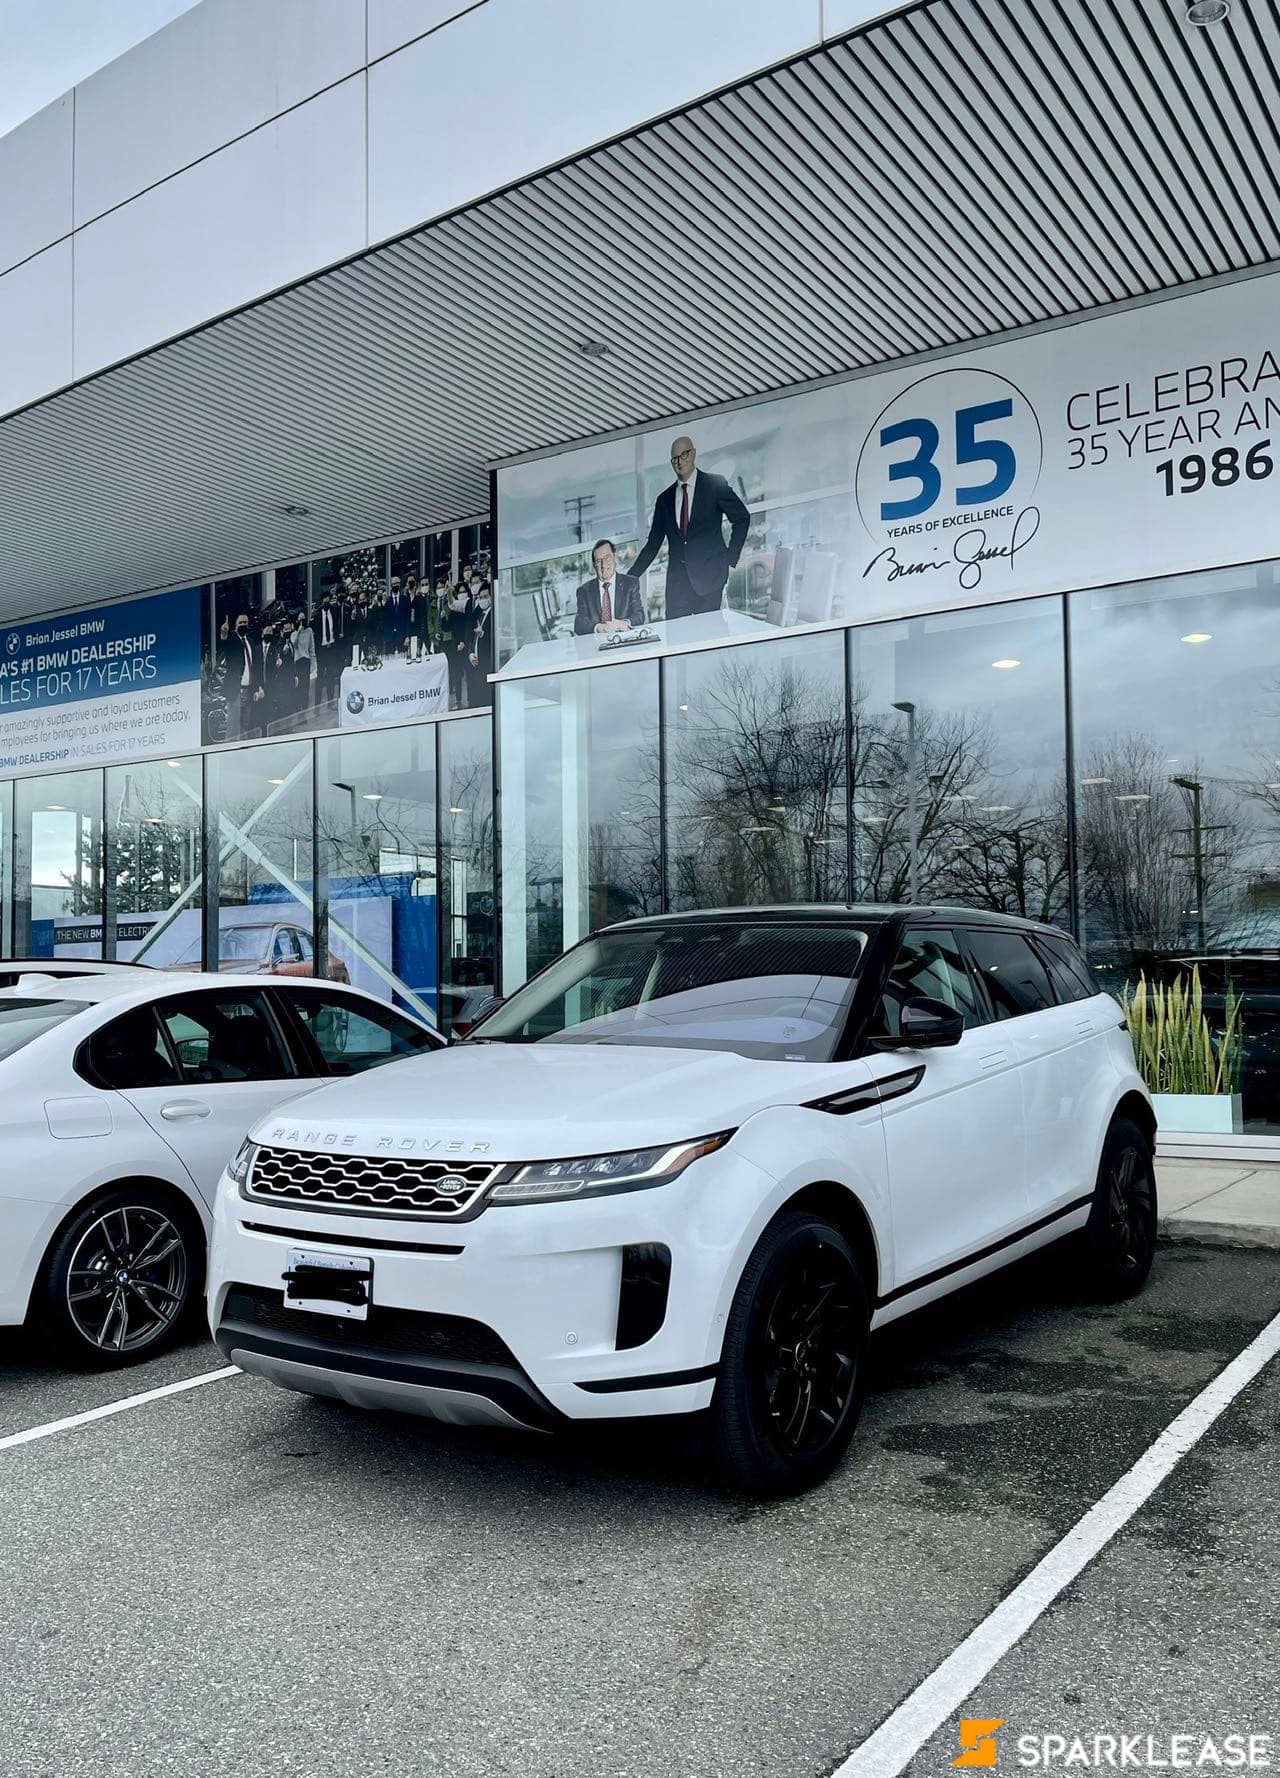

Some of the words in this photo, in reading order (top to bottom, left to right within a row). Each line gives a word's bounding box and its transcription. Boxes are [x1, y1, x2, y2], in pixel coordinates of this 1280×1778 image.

[1067, 350, 1280, 431] CELEBRA
[1068, 432, 1108, 470] 35
[1118, 408, 1222, 458] YEAR
[880, 397, 1017, 521] 35
[1156, 438, 1274, 497] 1986
[887, 522, 923, 539] YEARS
[925, 519, 941, 533] OF
[942, 505, 1014, 529] EXCELLENCE
[26, 633, 50, 647] Brian
[50, 625, 78, 643] Jessel
[80, 619, 105, 636] BMW
[0, 661, 19, 678] A'S
[21, 657, 34, 674] #1
[37, 650, 69, 671] BMW
[71, 633, 157, 665] DEALERSHIP
[0, 679, 31, 704] LES
[36, 671, 72, 699] FOR
[76, 667, 92, 691] 17
[96, 655, 157, 687] YEARS
[368, 696, 390, 707] Brian
[391, 690, 417, 703] Jessel
[419, 687, 441, 699] BMW
[4, 716, 45, 733] amazingly
[47, 709, 90, 726] supportive
[92, 704, 109, 718] and
[111, 700, 131, 716] loyal
[133, 694, 181, 711] customers
[40, 730, 51, 742] for
[53, 726, 87, 741] bringing
[89, 724, 99, 735] us
[101, 718, 128, 733] where
[130, 718, 143, 728] we
[145, 713, 160, 726] are
[19, 748, 69, 765] DEALERSHIP
[81, 741, 107, 757] SALES
[109, 739, 126, 752] FOR
[137, 733, 166, 747] YEARS
[56, 931, 72, 940] THE
[72, 930, 90, 939] NEW
[90, 929, 103, 939] BM
[271, 1128, 358, 1146] RANGE
[376, 1136, 491, 1153] ROVER
